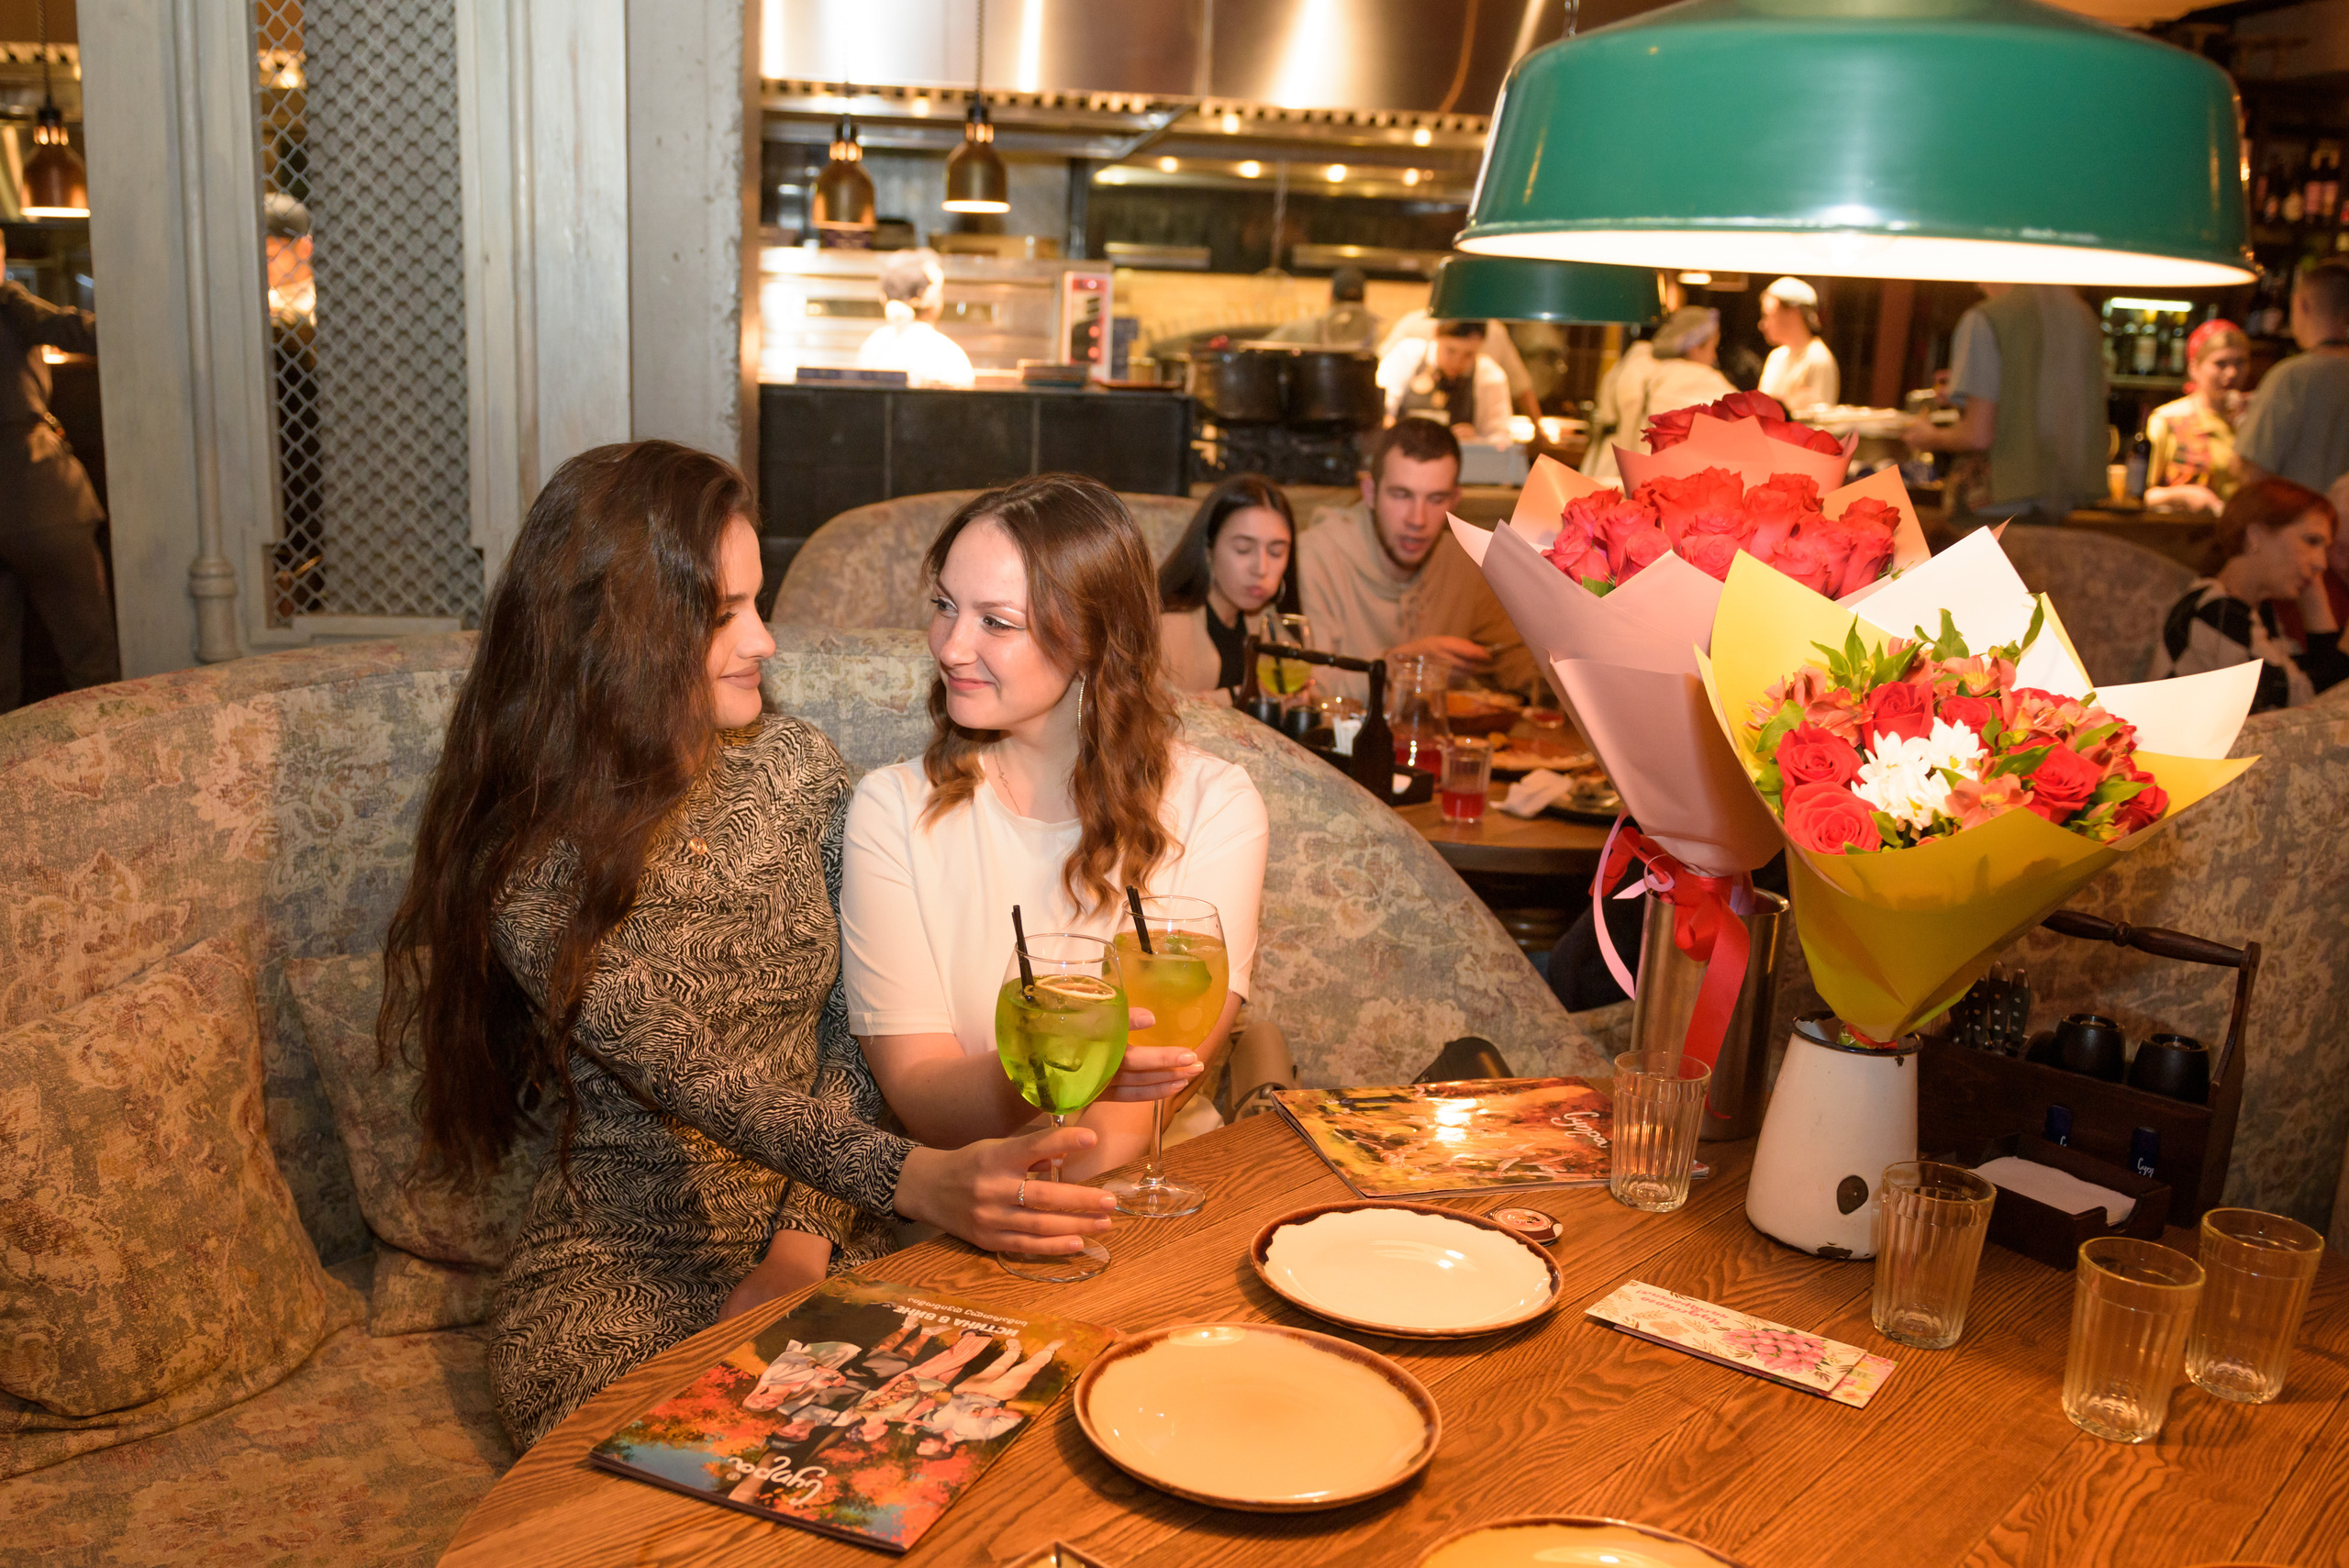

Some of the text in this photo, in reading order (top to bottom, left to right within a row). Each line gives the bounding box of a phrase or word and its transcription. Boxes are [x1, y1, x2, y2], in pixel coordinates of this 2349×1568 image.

[1550, 1111, 1608, 1149] Супра
[892, 1305, 1019, 1338] ИСТИНА В ВИНЕ
[728, 1455, 828, 1507] Супра
